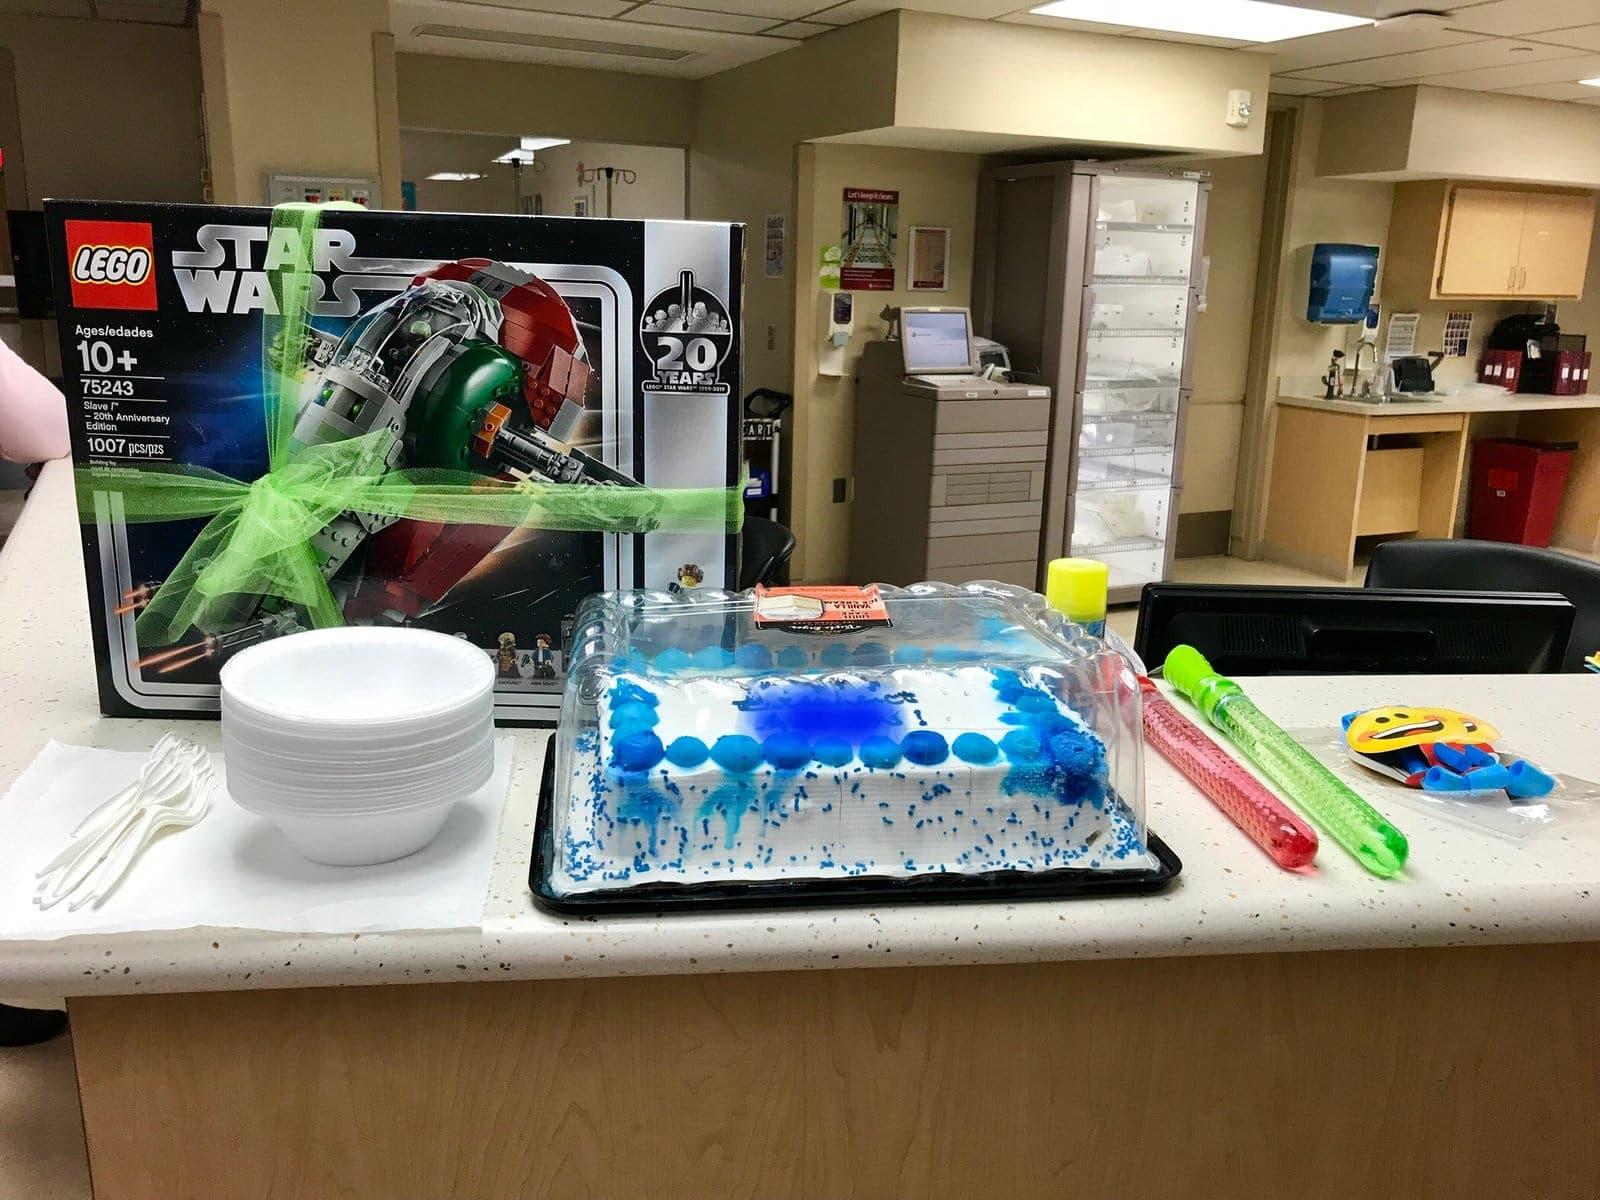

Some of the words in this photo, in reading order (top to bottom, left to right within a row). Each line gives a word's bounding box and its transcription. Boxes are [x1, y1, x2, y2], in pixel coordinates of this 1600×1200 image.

[172, 224, 358, 273] STAR
[75, 247, 149, 283] LEGO
[174, 268, 361, 318] WARS
[75, 324, 154, 339] Ages/edades
[76, 340, 138, 373] 10+
[657, 336, 718, 372] 20
[656, 370, 716, 385] YEARS
[80, 379, 134, 396] 75243
[83, 401, 109, 411] Slave
[86, 421, 117, 432] Edition
[94, 412, 113, 421] 20th
[116, 413, 170, 425] Anniversary
[87, 437, 126, 454] 1007
[128, 442, 165, 457] pcs/pzs
